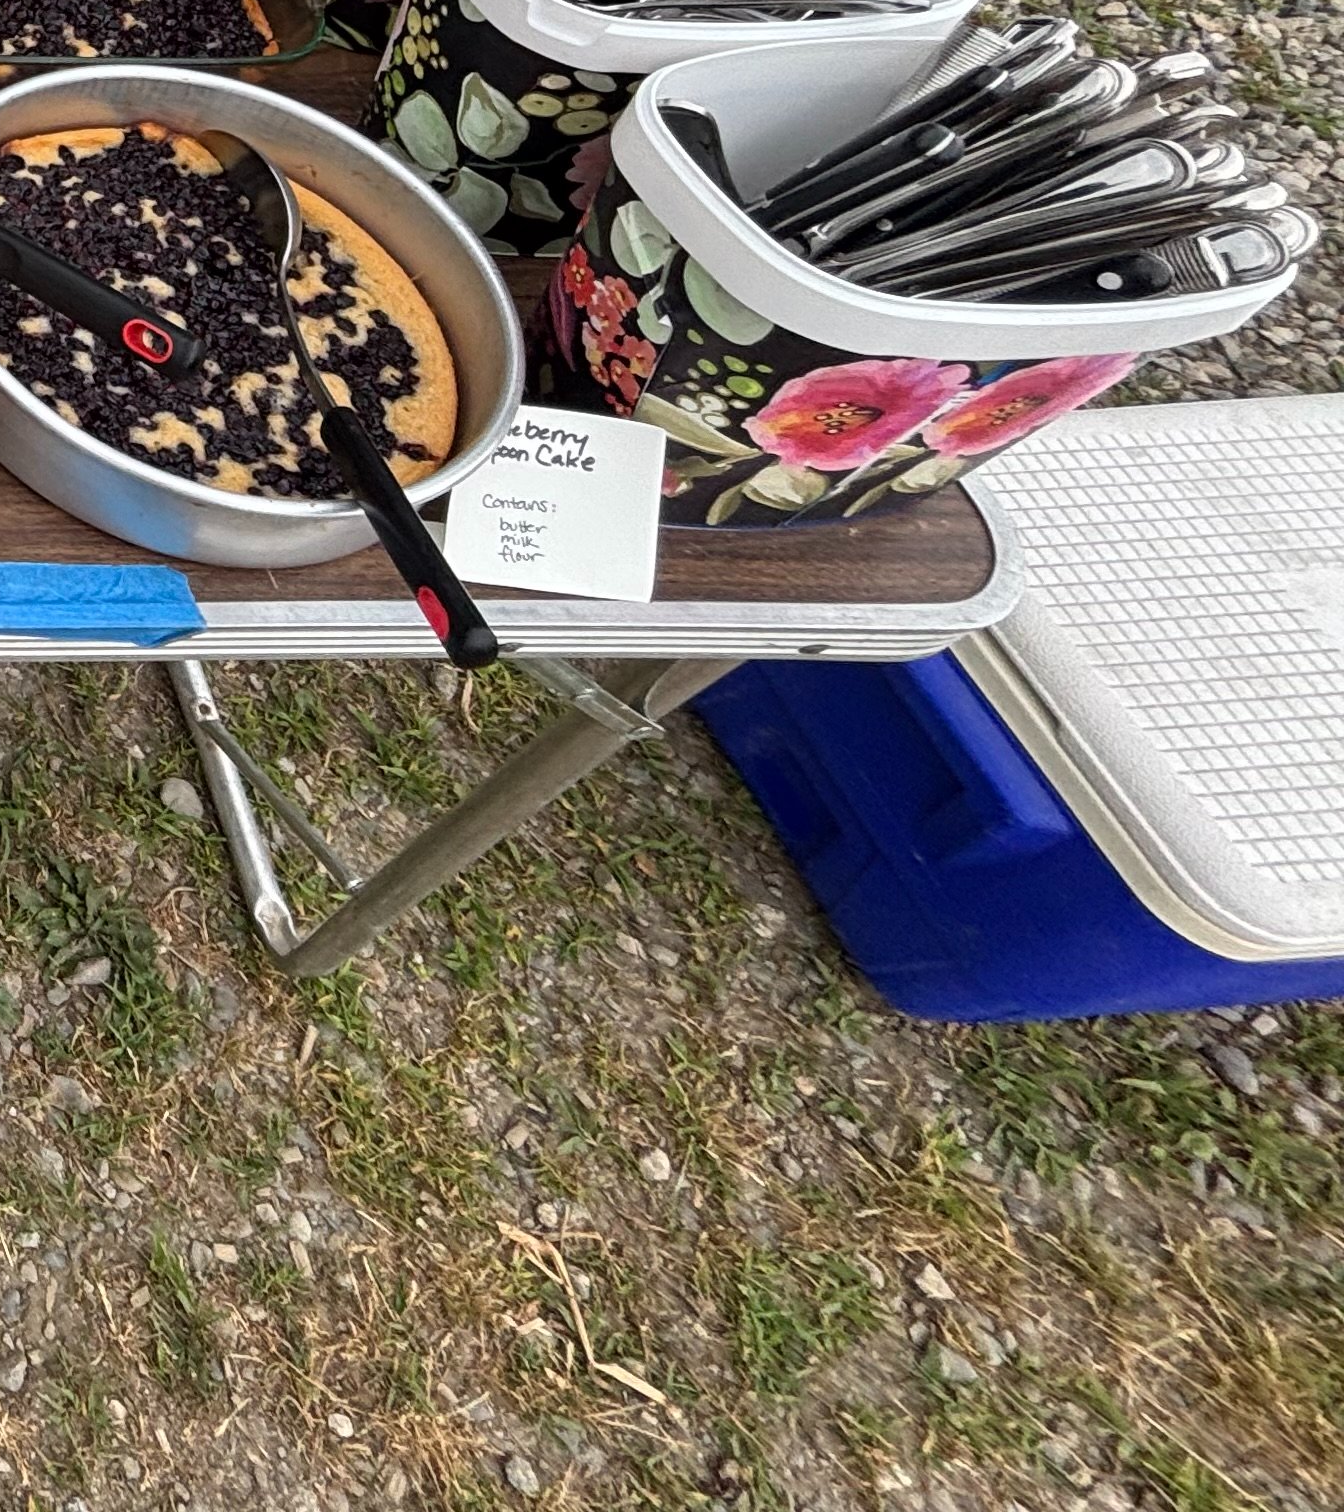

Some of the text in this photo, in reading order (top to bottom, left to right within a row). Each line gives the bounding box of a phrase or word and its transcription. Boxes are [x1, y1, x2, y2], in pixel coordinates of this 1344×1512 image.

[506, 420, 589, 455] eberry
[491, 444, 596, 472] poon Cake
[499, 517, 548, 534] butter
[501, 533, 540, 548] milk
[498, 546, 545, 564] flour
